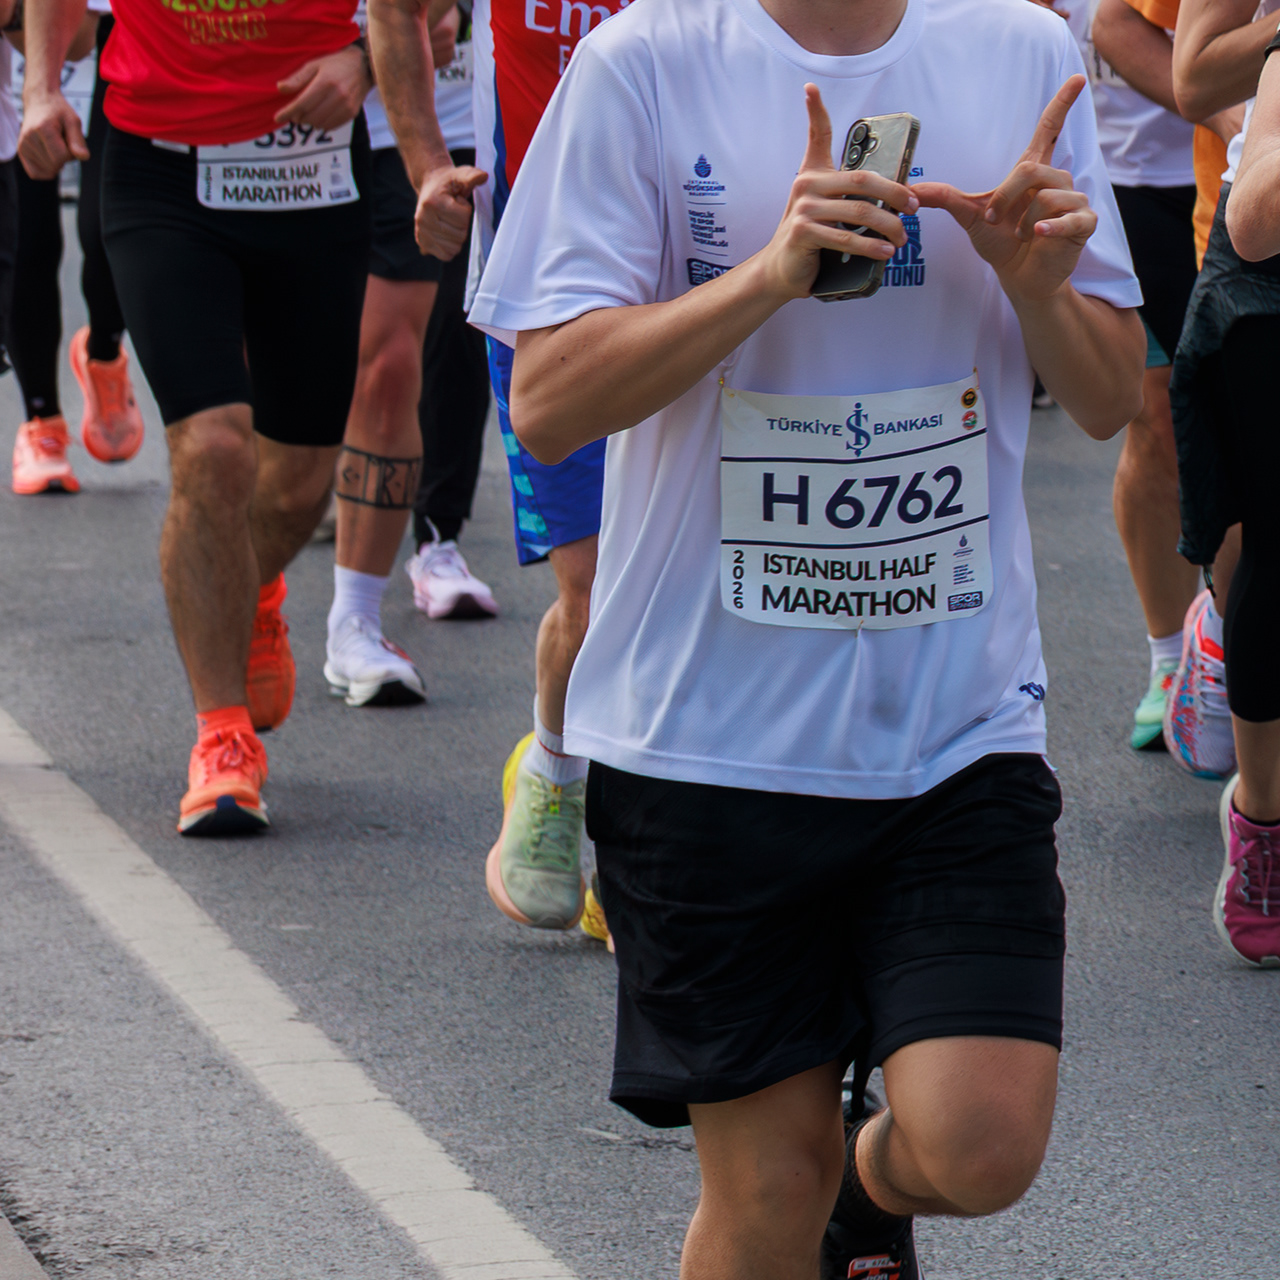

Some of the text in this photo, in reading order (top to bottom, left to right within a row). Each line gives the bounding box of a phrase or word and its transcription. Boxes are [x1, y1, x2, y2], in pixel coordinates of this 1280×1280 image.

[222, 165, 290, 182] ISTANBUL
[222, 183, 322, 204] MARATHON
[881, 266, 925, 287] TONU
[766, 417, 842, 437] TÜRKİYE
[873, 414, 943, 436] BANKASI
[762, 465, 963, 530] H 6762
[763, 553, 876, 581] ISTANBUL
[880, 552, 937, 581] HALF
[733, 550, 744, 609] 2026
[761, 583, 936, 617] MARATHON
[949, 593, 980, 605] SPOR
